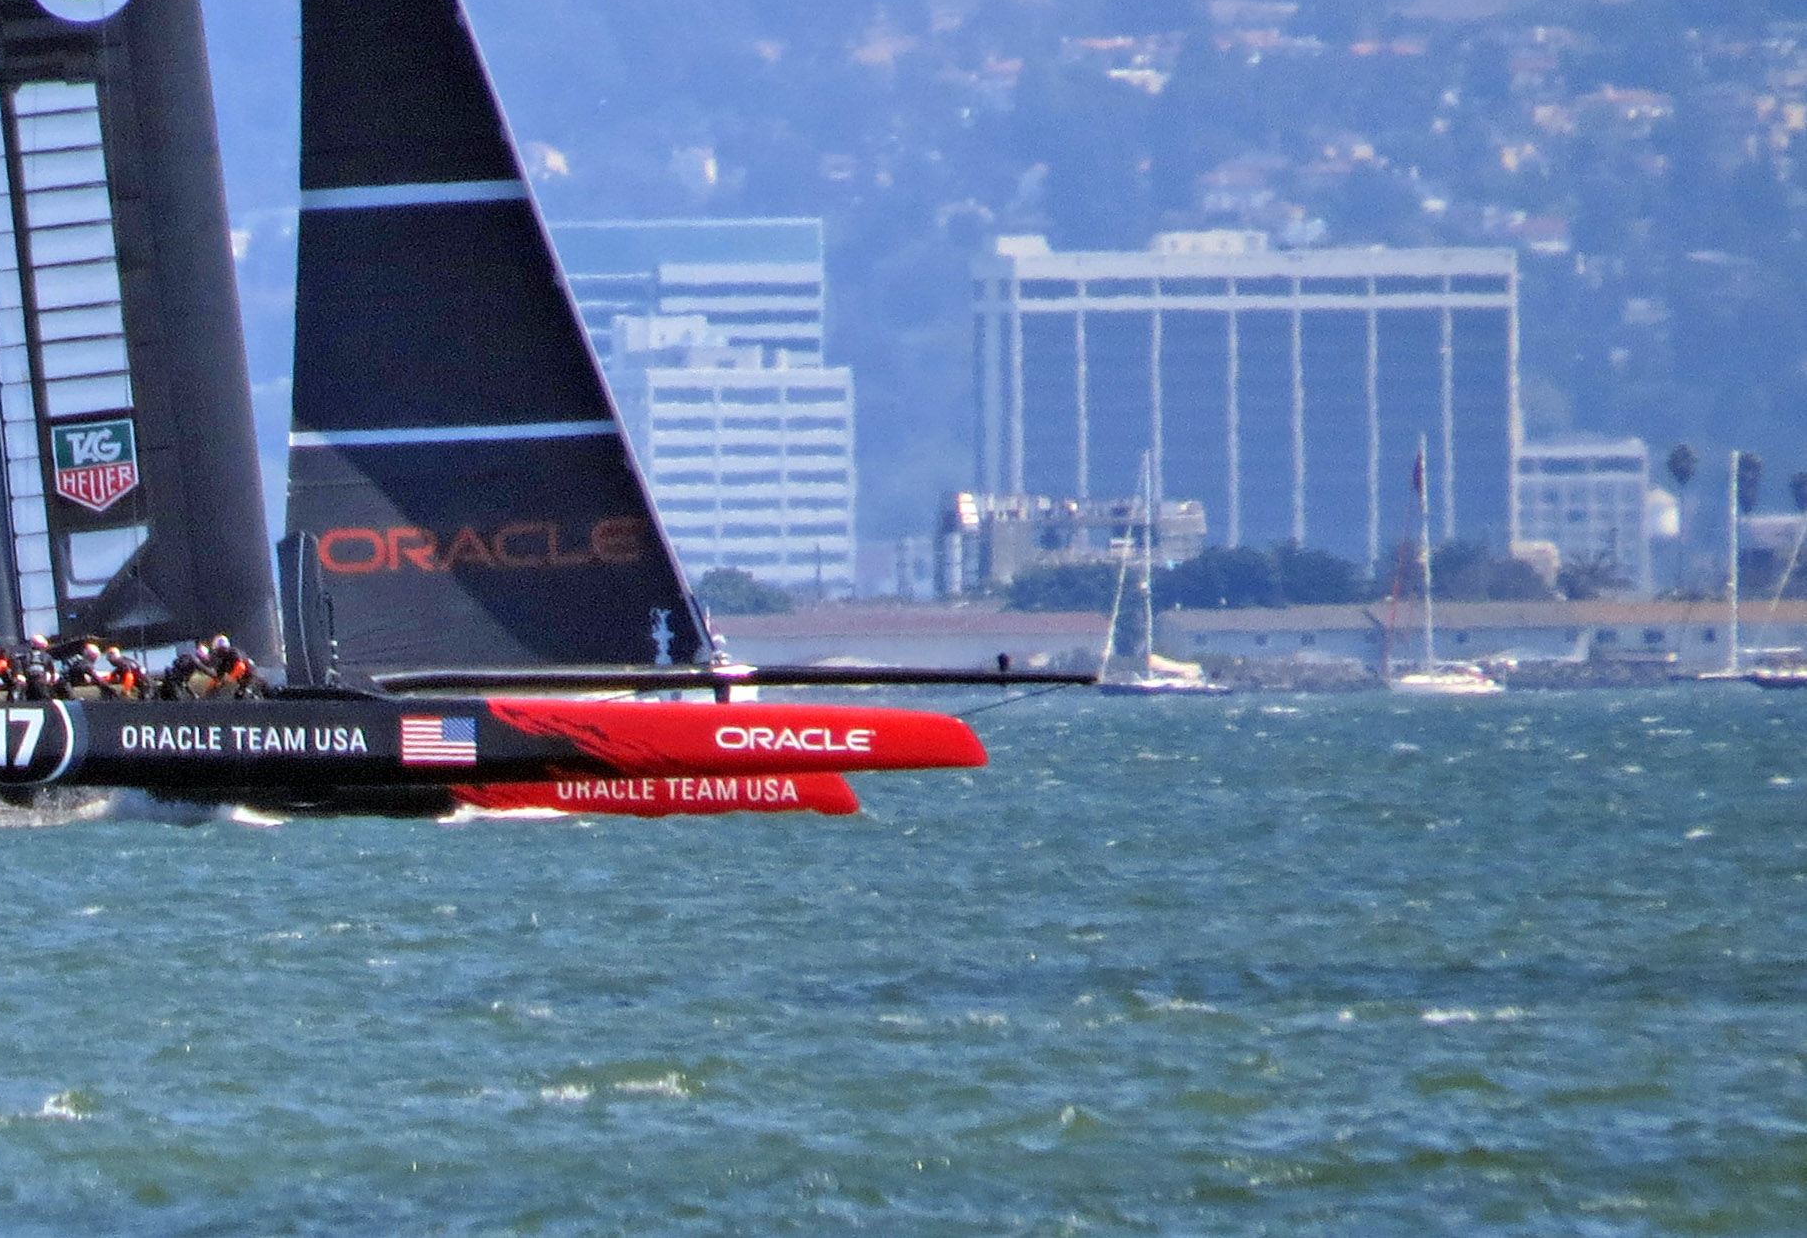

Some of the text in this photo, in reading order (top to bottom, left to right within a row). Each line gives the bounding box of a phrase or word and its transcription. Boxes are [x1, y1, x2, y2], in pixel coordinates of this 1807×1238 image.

[65, 427, 122, 467] TAG
[62, 462, 134, 505] HEUER
[317, 515, 648, 574] ORACLE
[121, 724, 368, 753] ORACLE TEAM USA
[714, 726, 872, 752] ORACLE
[557, 777, 798, 802] ORACLE TEAM USA
